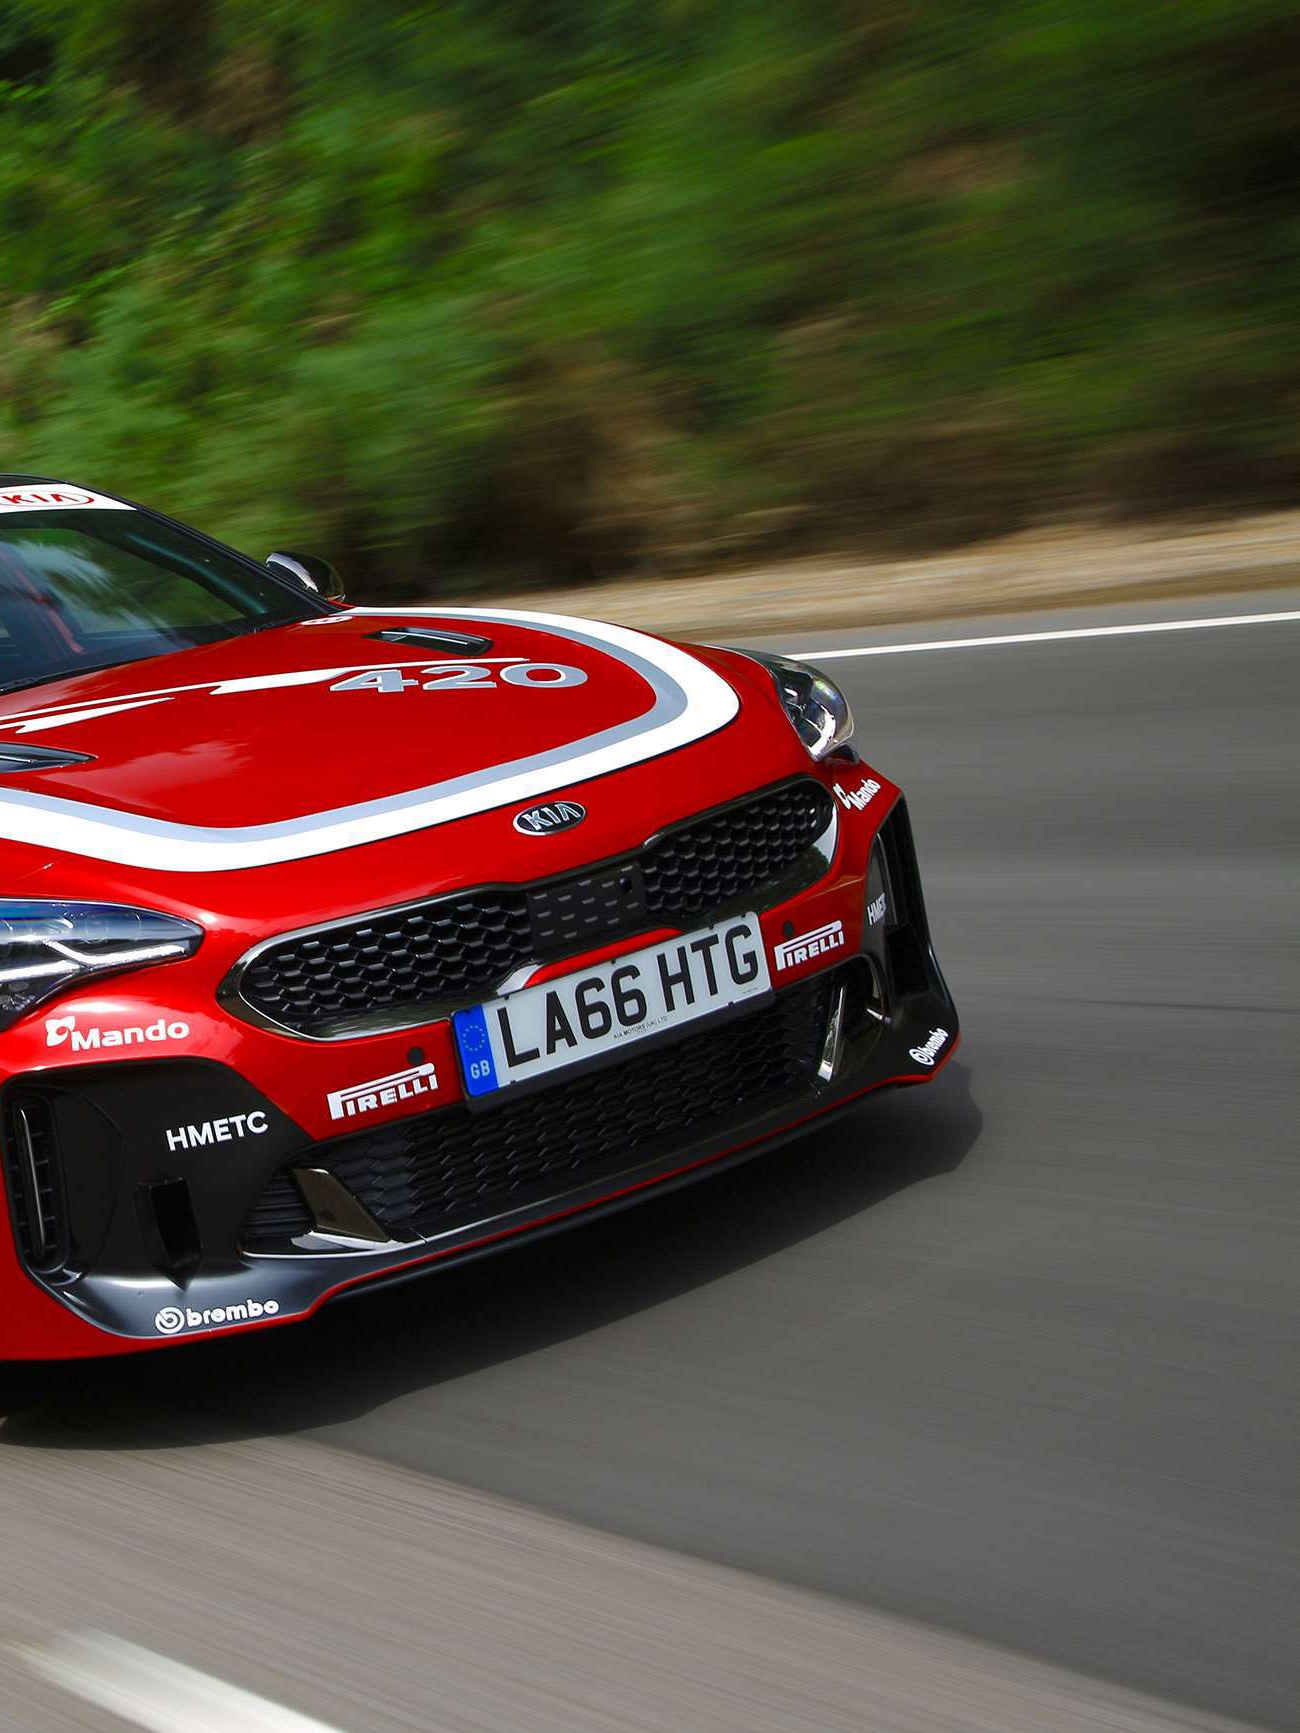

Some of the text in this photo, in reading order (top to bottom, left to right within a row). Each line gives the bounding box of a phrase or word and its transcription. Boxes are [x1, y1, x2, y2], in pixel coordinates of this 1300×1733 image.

[329, 662, 589, 693] 420
[846, 778, 881, 811] Mando
[521, 802, 582, 832] KIA
[773, 919, 845, 972] PIRELLI
[496, 923, 759, 1069] LA66 HTG
[71, 1018, 190, 1052] Mando
[916, 1027, 949, 1059] brembo
[470, 1059, 491, 1080] GB
[326, 1062, 439, 1121] PIRELLI
[165, 1110, 269, 1152] HMETC
[185, 1298, 280, 1328] brembo
